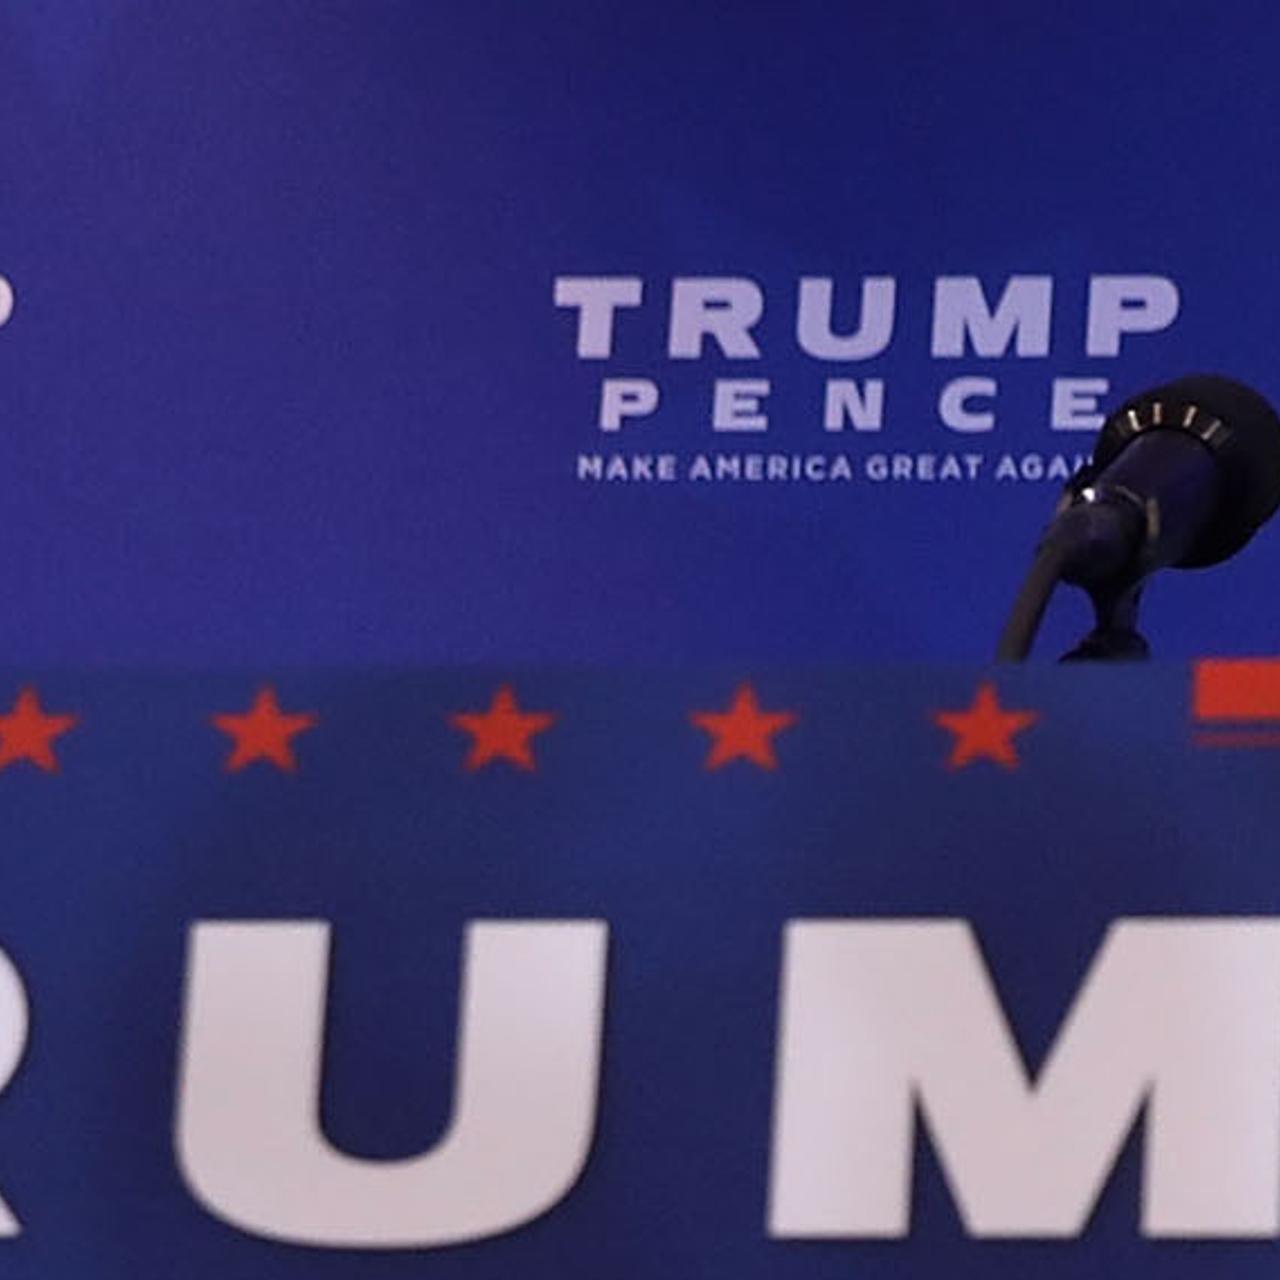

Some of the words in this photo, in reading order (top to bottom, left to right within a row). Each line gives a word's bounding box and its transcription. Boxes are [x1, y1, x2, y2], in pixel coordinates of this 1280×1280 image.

[554, 275, 1180, 361] TRUMP
[600, 377, 1110, 431] PENCE
[576, 455, 676, 480] MAKE
[690, 455, 852, 480] AMERICA
[866, 454, 982, 480] GREAT
[996, 453, 1094, 480] AGA
